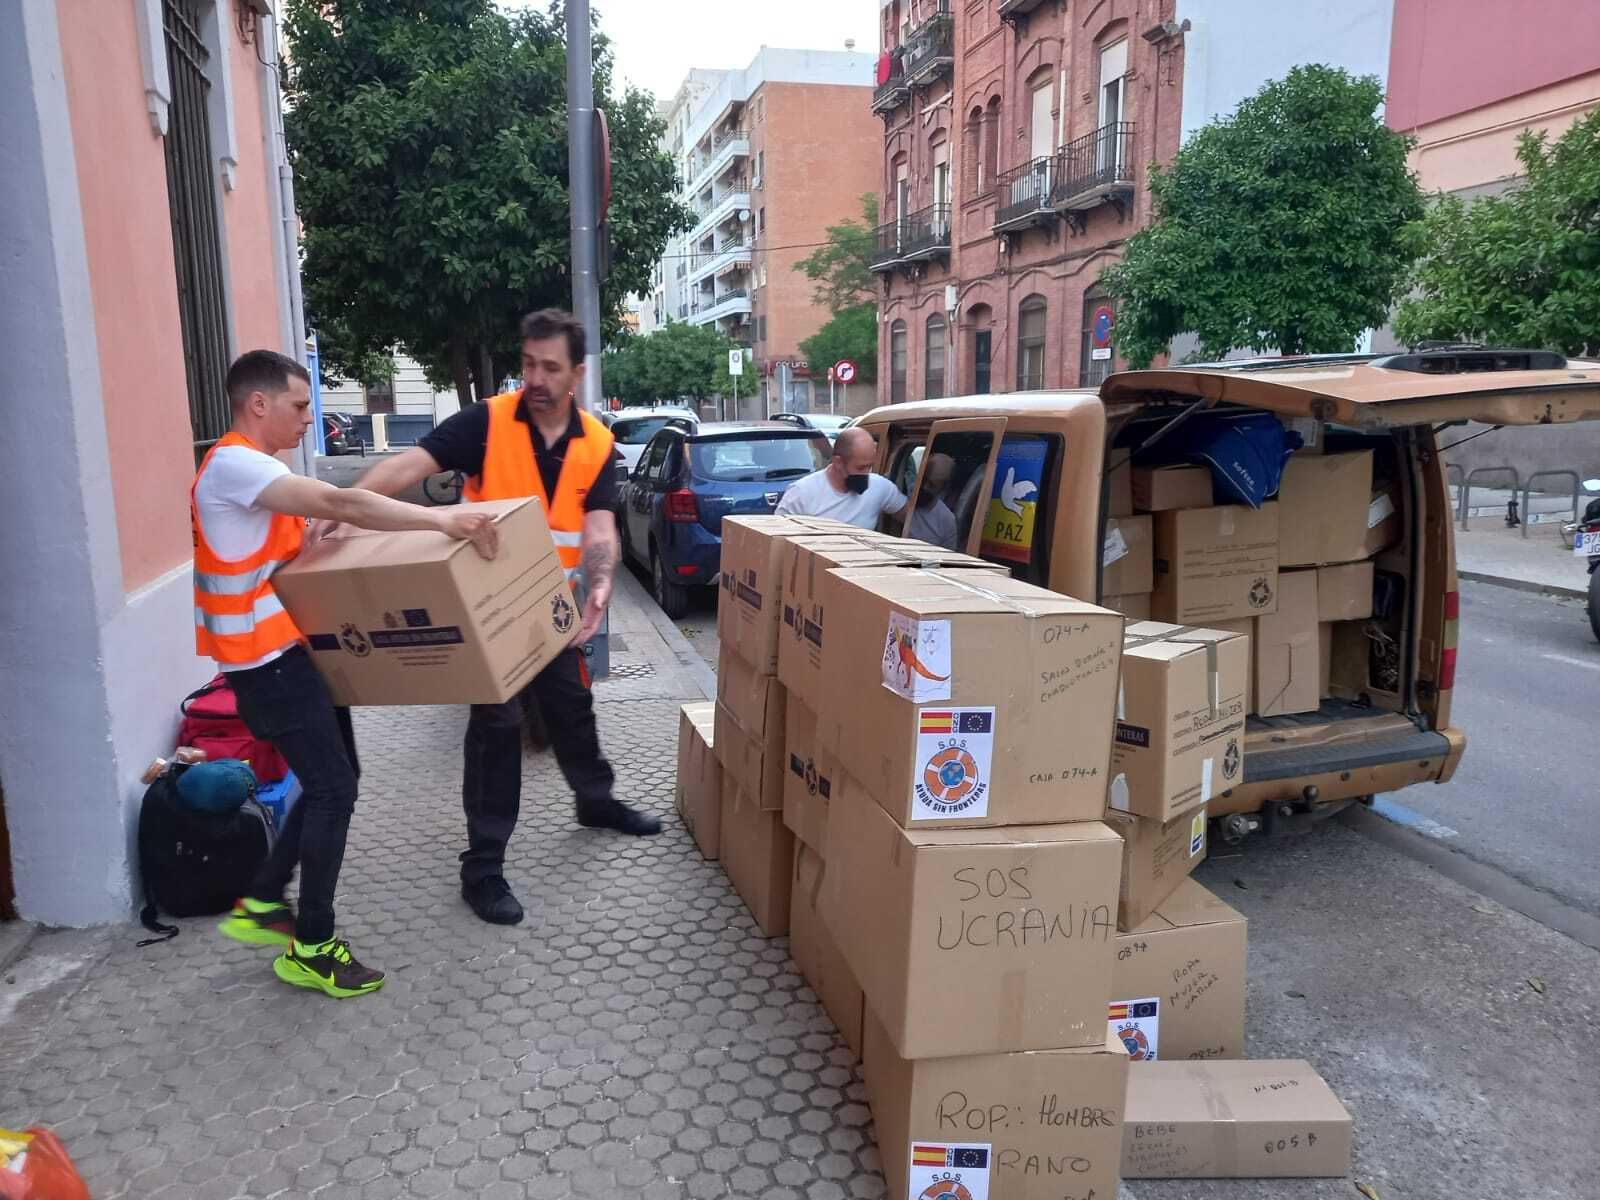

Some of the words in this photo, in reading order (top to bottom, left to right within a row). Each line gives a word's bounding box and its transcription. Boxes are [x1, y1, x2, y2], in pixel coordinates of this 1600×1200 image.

[994, 521, 1024, 542] PAZ
[915, 783, 932, 808] AYUDA
[932, 802, 947, 814] SIN
[948, 782, 987, 814] FRONTERAS
[953, 866, 1033, 901] SOS
[937, 902, 1115, 951] UCRANIA
[996, 1149, 1092, 1177] RANO
